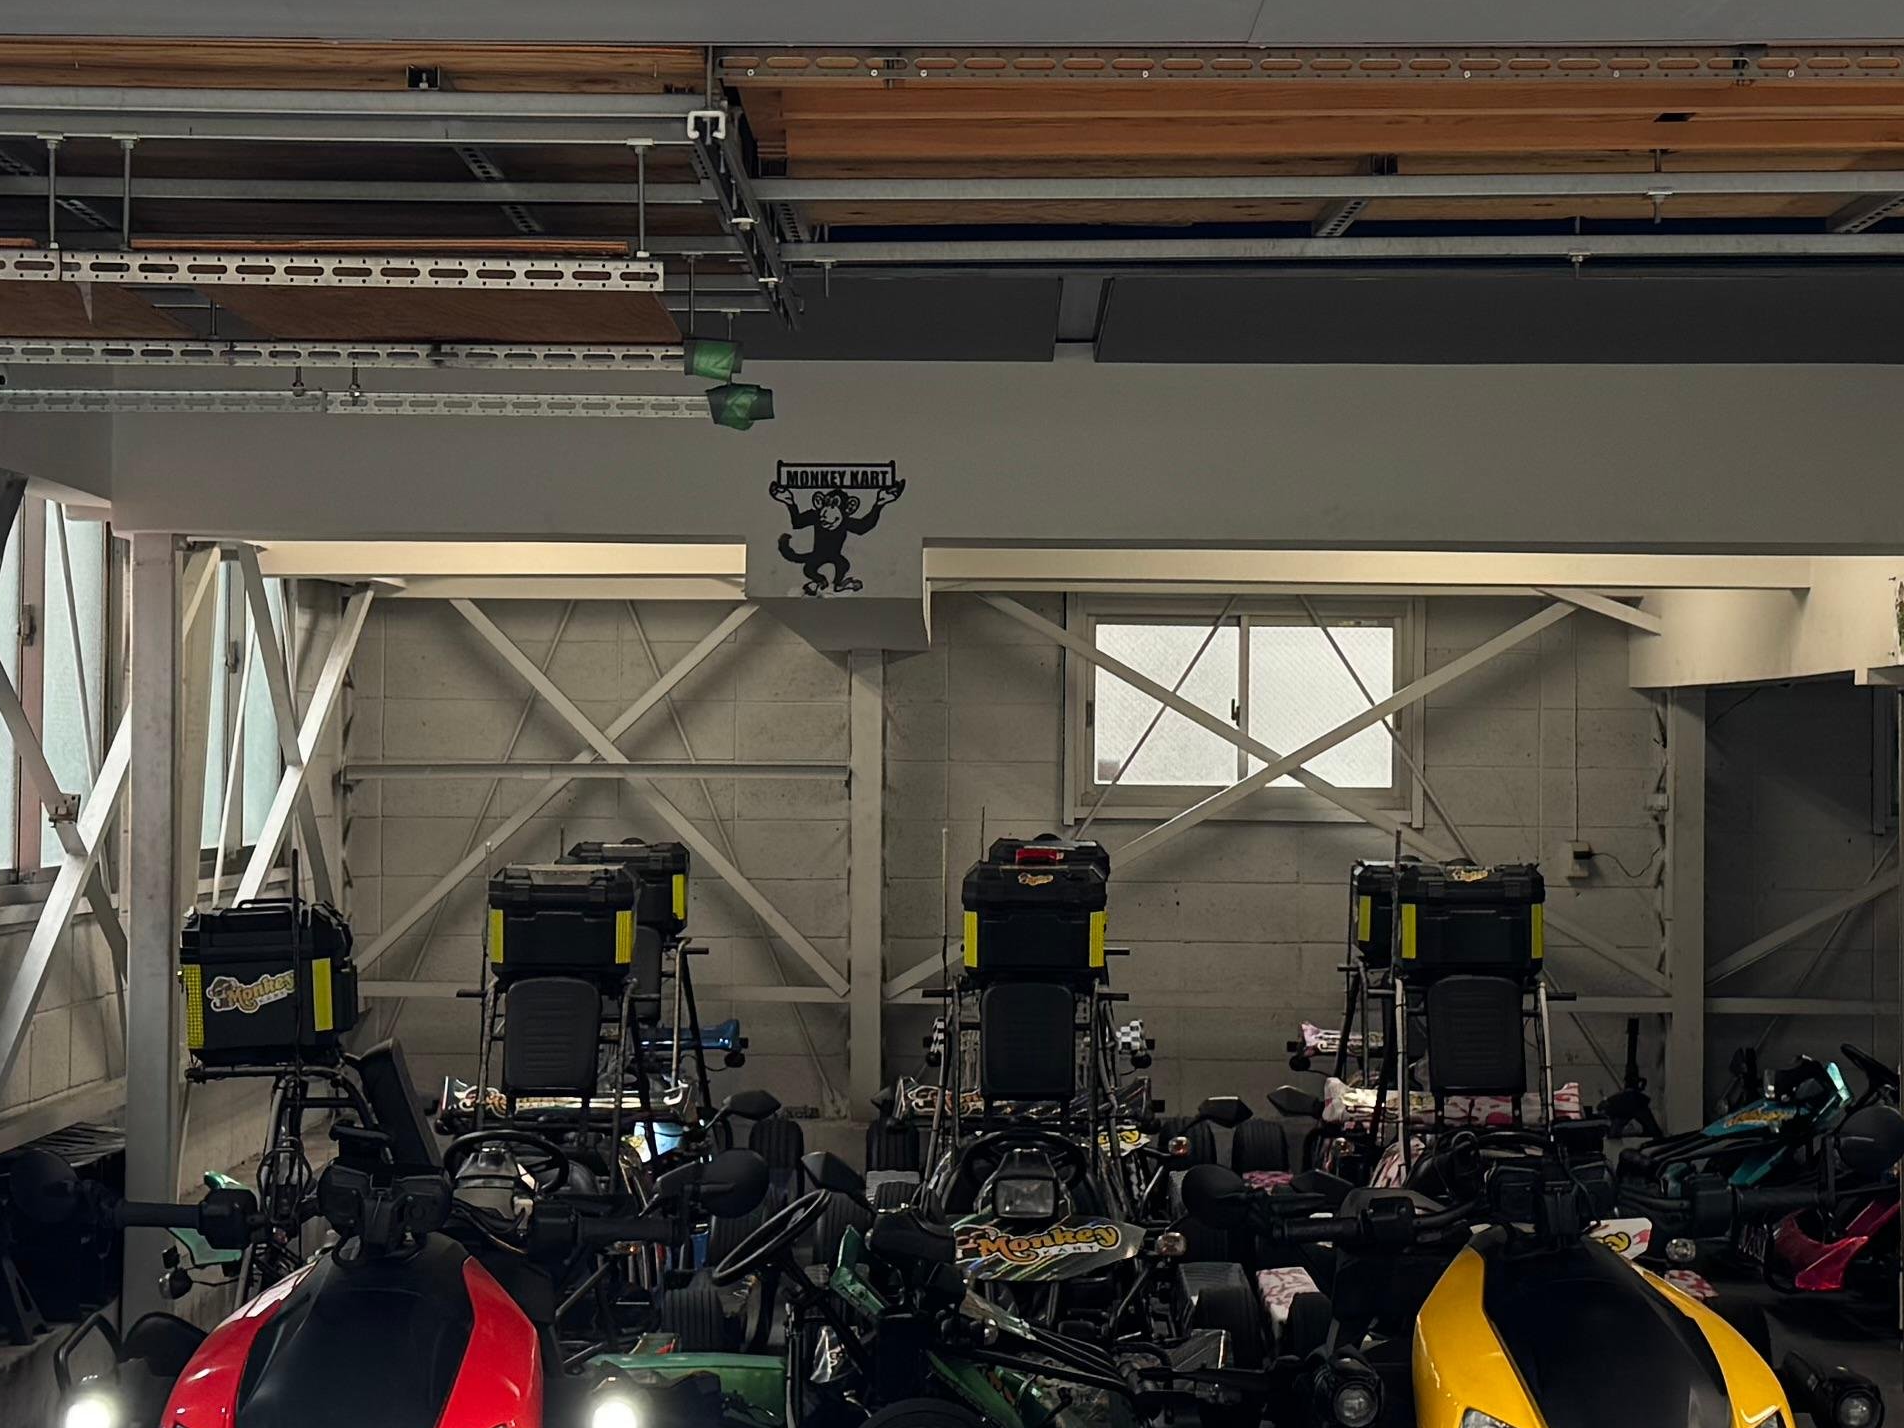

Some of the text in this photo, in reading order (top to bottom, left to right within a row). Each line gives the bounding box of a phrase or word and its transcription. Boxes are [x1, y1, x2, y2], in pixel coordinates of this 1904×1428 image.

[786, 470, 889, 487] MONKEY KART
[227, 972, 295, 1010] Monkey
[974, 1224, 1121, 1264] Monkey
